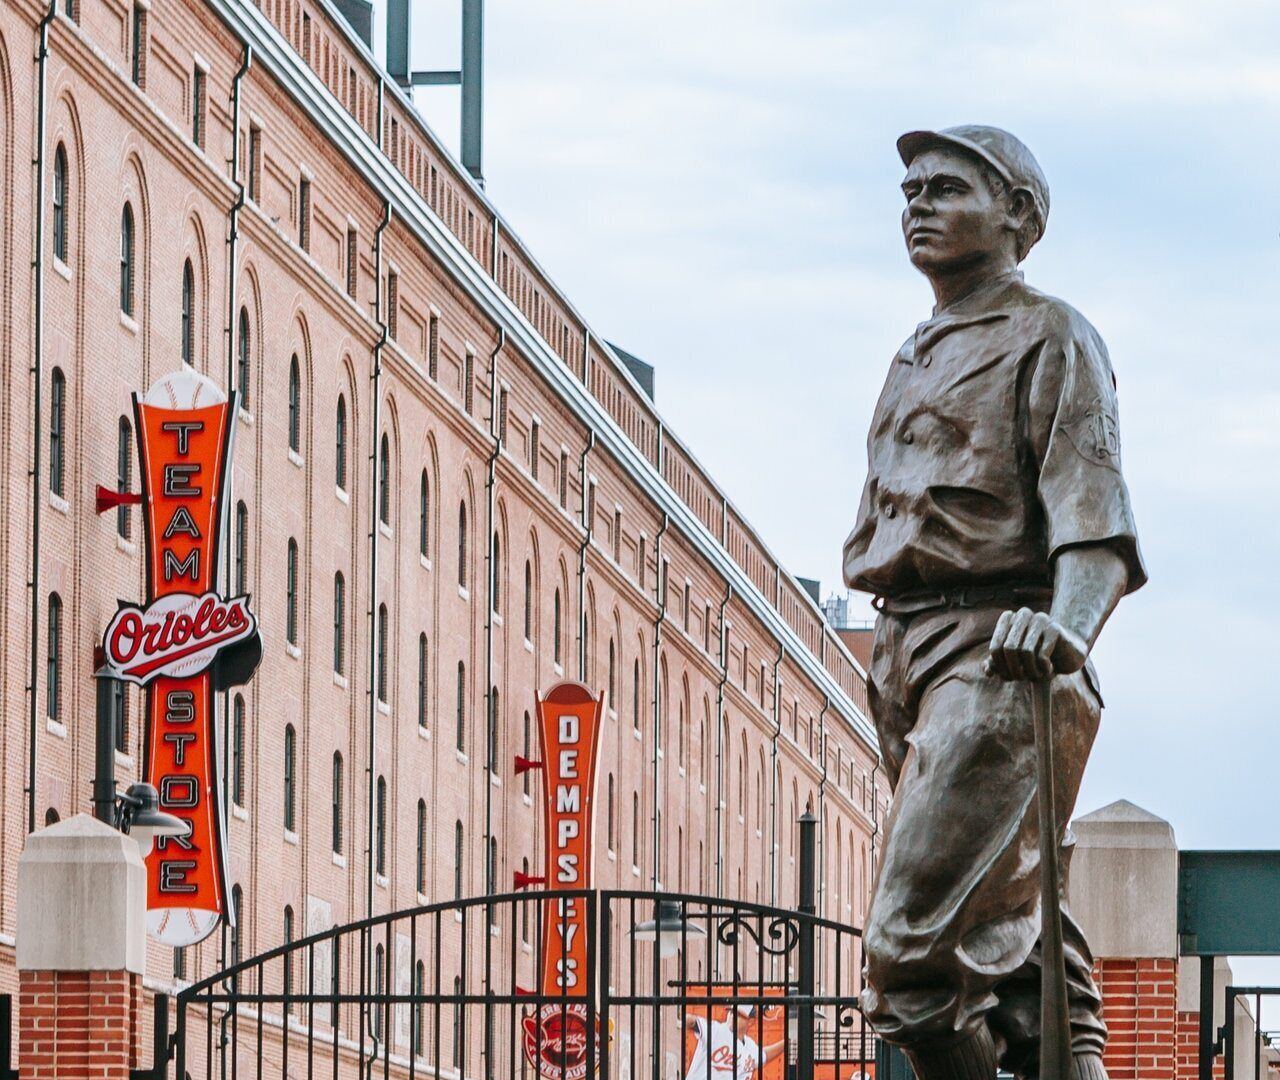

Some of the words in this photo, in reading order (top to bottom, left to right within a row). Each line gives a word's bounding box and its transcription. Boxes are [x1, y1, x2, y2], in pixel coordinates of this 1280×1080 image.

[162, 421, 205, 581] TEAM
[110, 597, 249, 678] Orioles
[556, 715, 580, 987] DEMPSEYS
